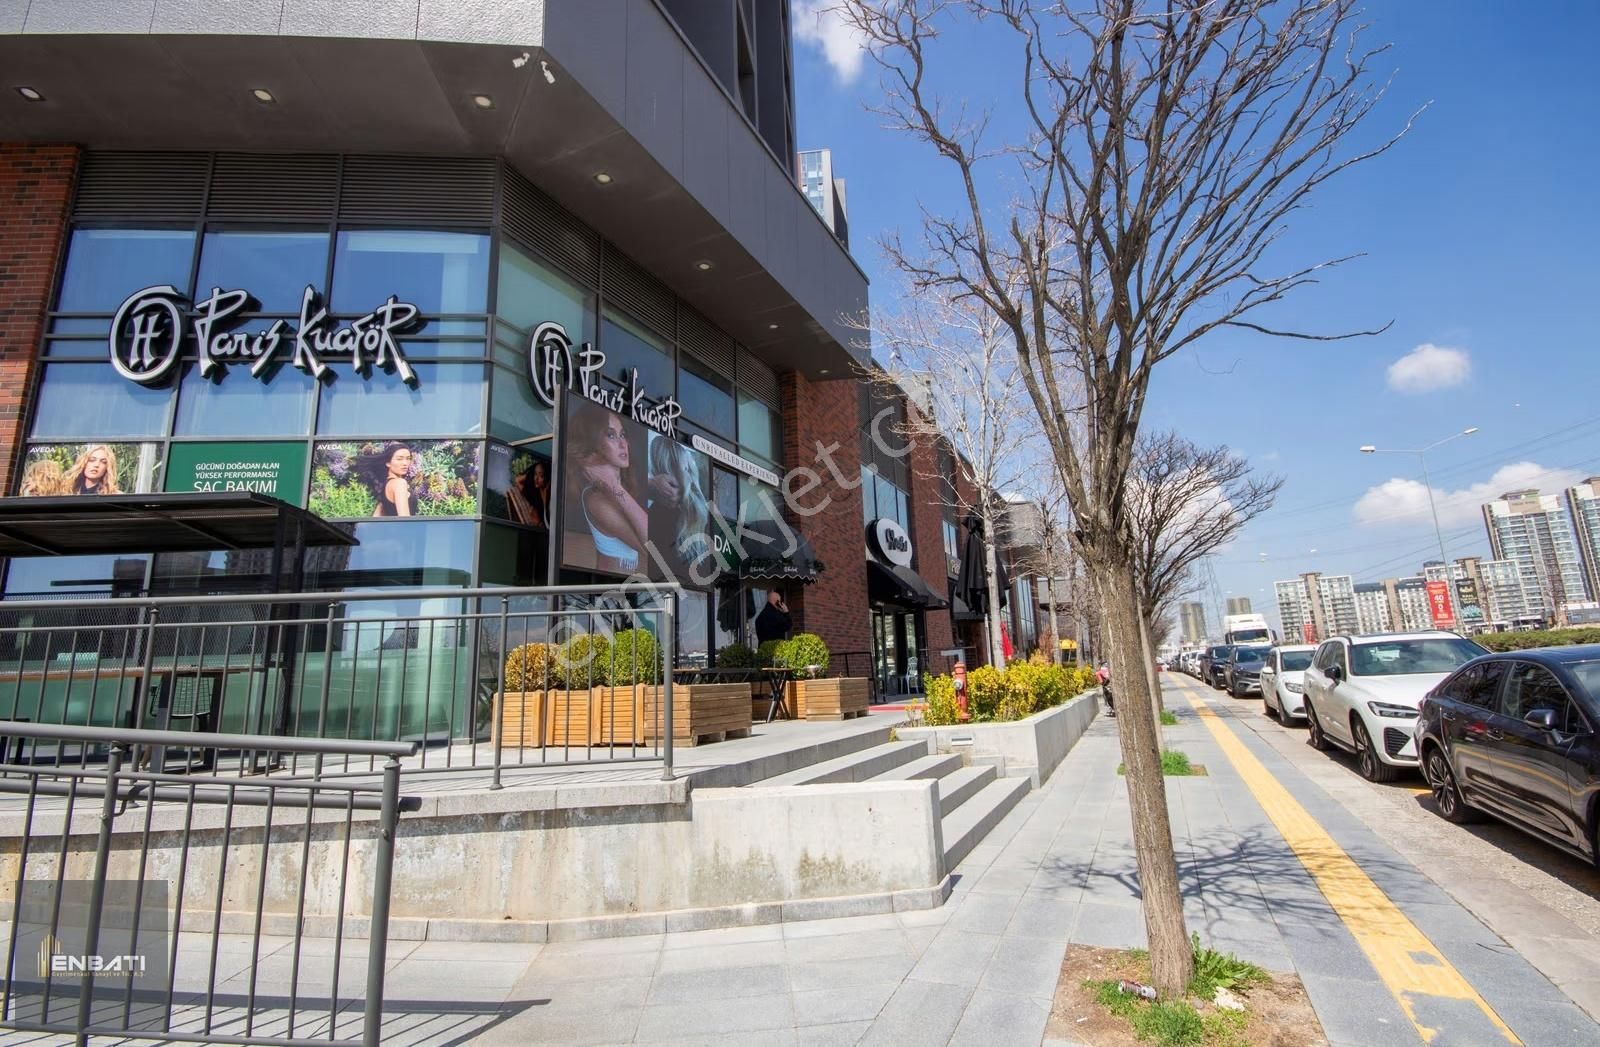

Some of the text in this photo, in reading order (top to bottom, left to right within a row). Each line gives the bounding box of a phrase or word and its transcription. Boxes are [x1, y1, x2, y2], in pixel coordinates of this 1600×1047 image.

[195, 287, 284, 378] Paris
[226, 461, 260, 470] DOĞADAN
[695, 437, 777, 483] UNRIVALLED EXPERIENCE
[195, 470, 278, 479] YÜKSEK PERFORMANSLI
[225, 480, 277, 493] BAKIMI
